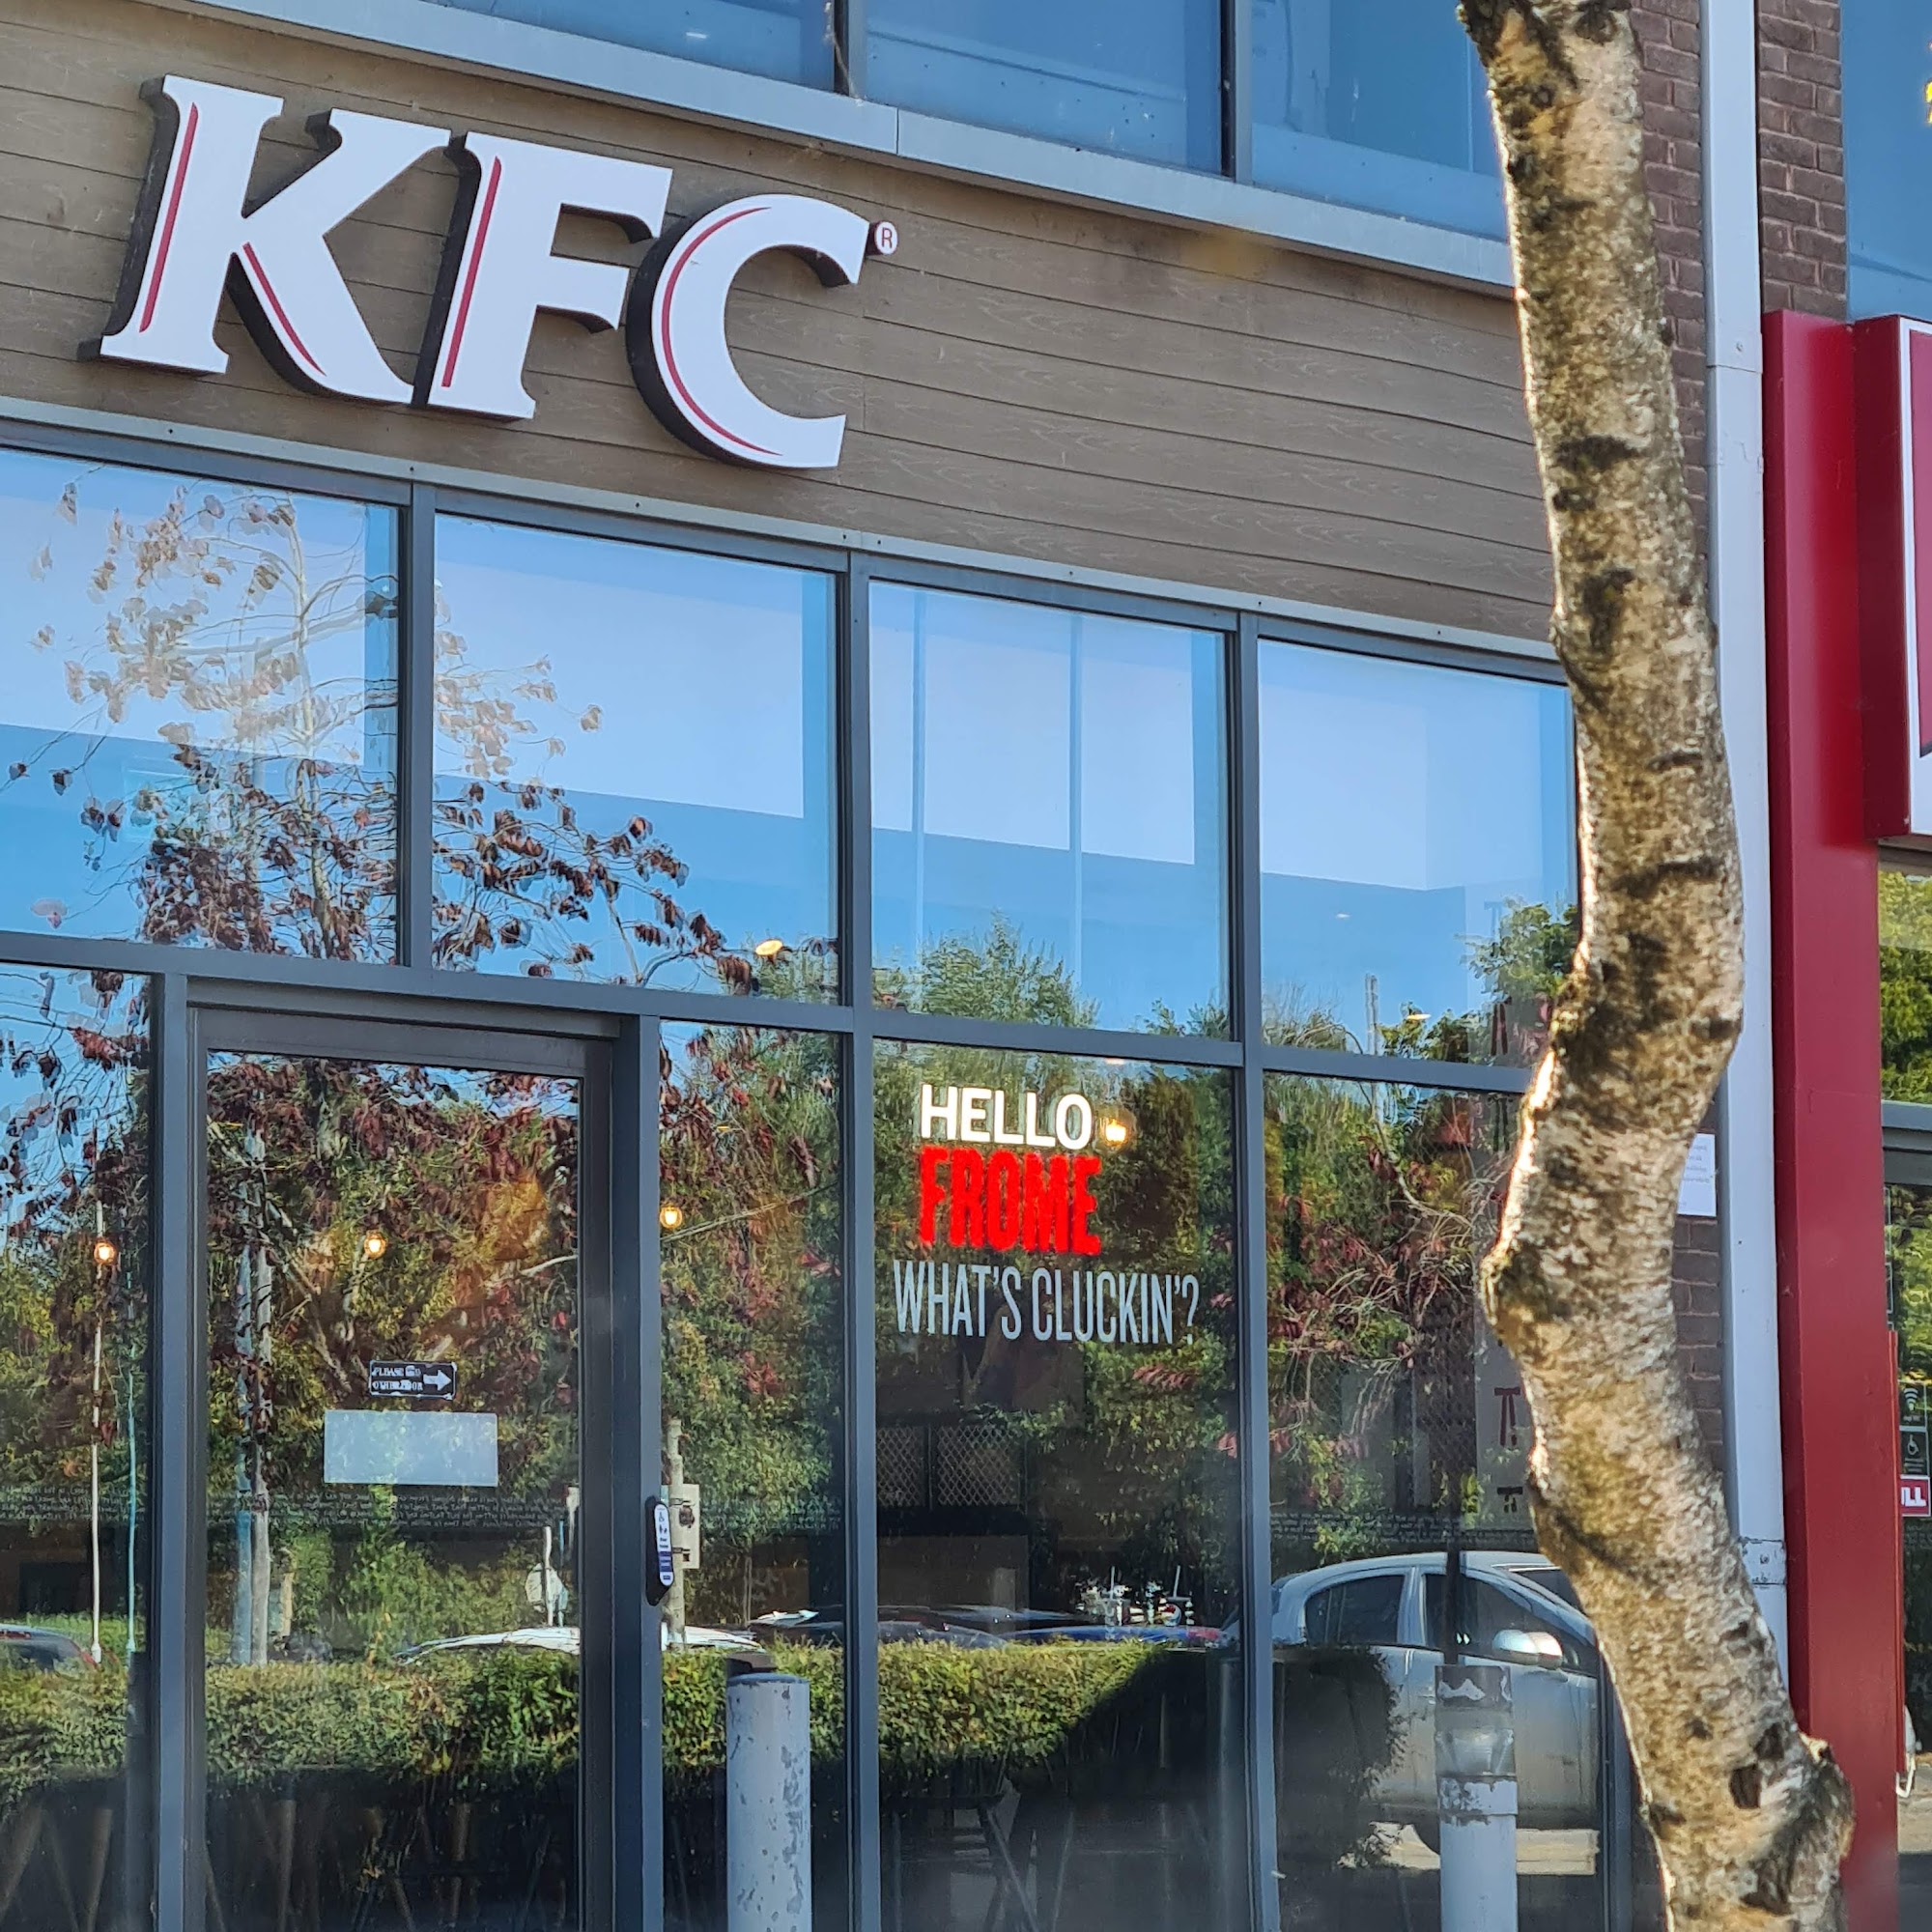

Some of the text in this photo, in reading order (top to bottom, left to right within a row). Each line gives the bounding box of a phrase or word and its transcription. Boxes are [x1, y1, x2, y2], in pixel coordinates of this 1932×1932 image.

[99, 74, 870, 469] KFC
[921, 1084, 1093, 1150] HELLO
[919, 1146, 1101, 1255] FROME
[893, 1259, 1200, 1346] WHAT'S CLUCKIN'?
